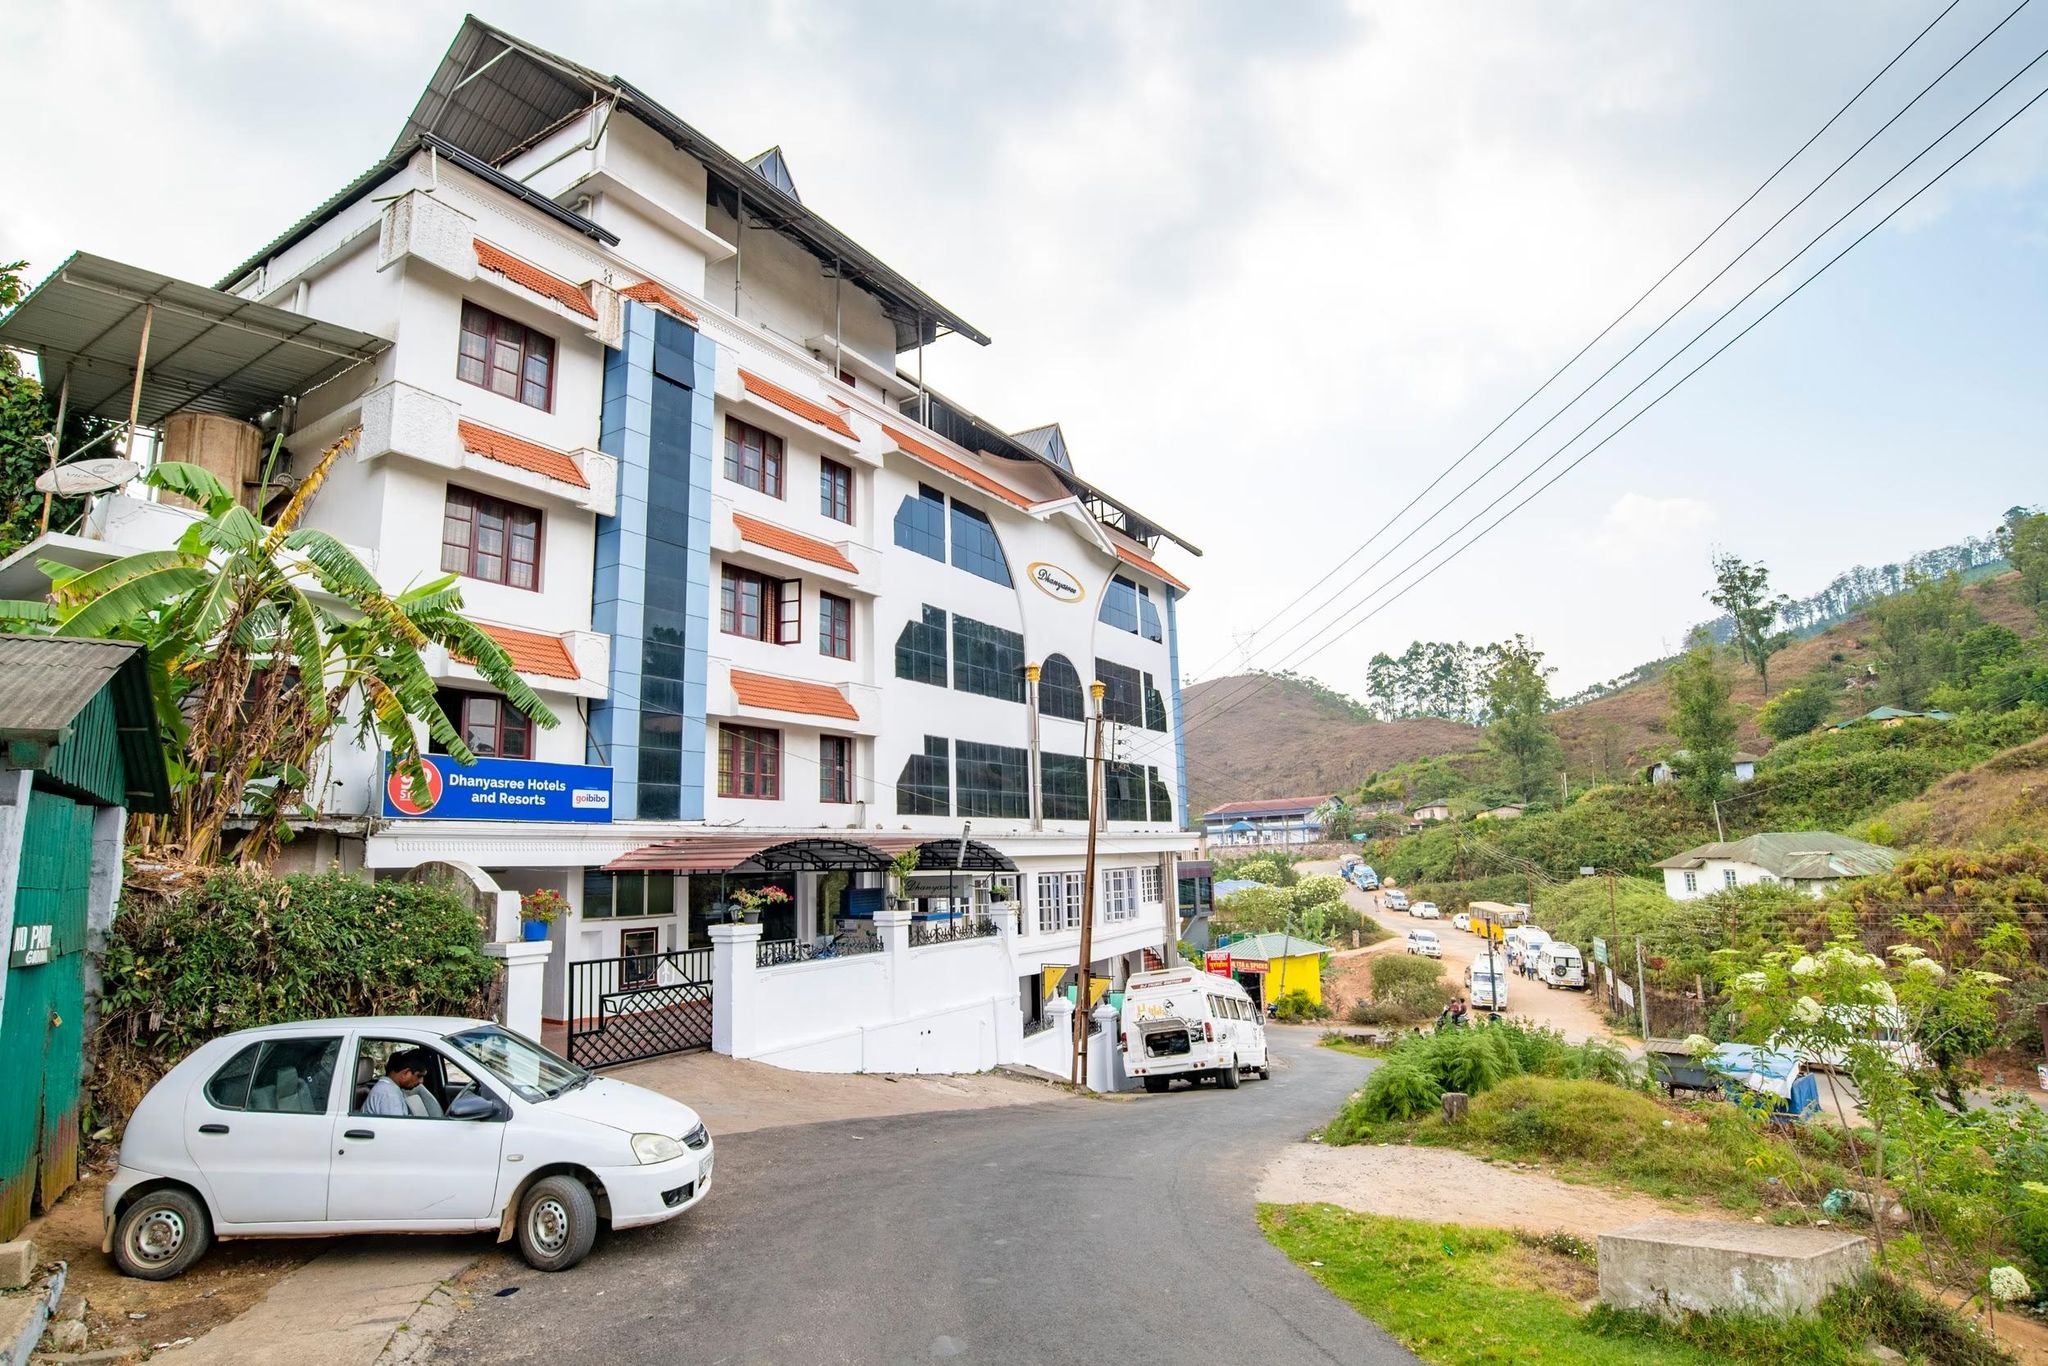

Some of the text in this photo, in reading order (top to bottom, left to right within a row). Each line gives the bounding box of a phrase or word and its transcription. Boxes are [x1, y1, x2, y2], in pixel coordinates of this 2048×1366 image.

[448, 773, 567, 792] Dhanyasree Hotels
[471, 791, 546, 806] and Resorts
[575, 793, 606, 804] goibibo
